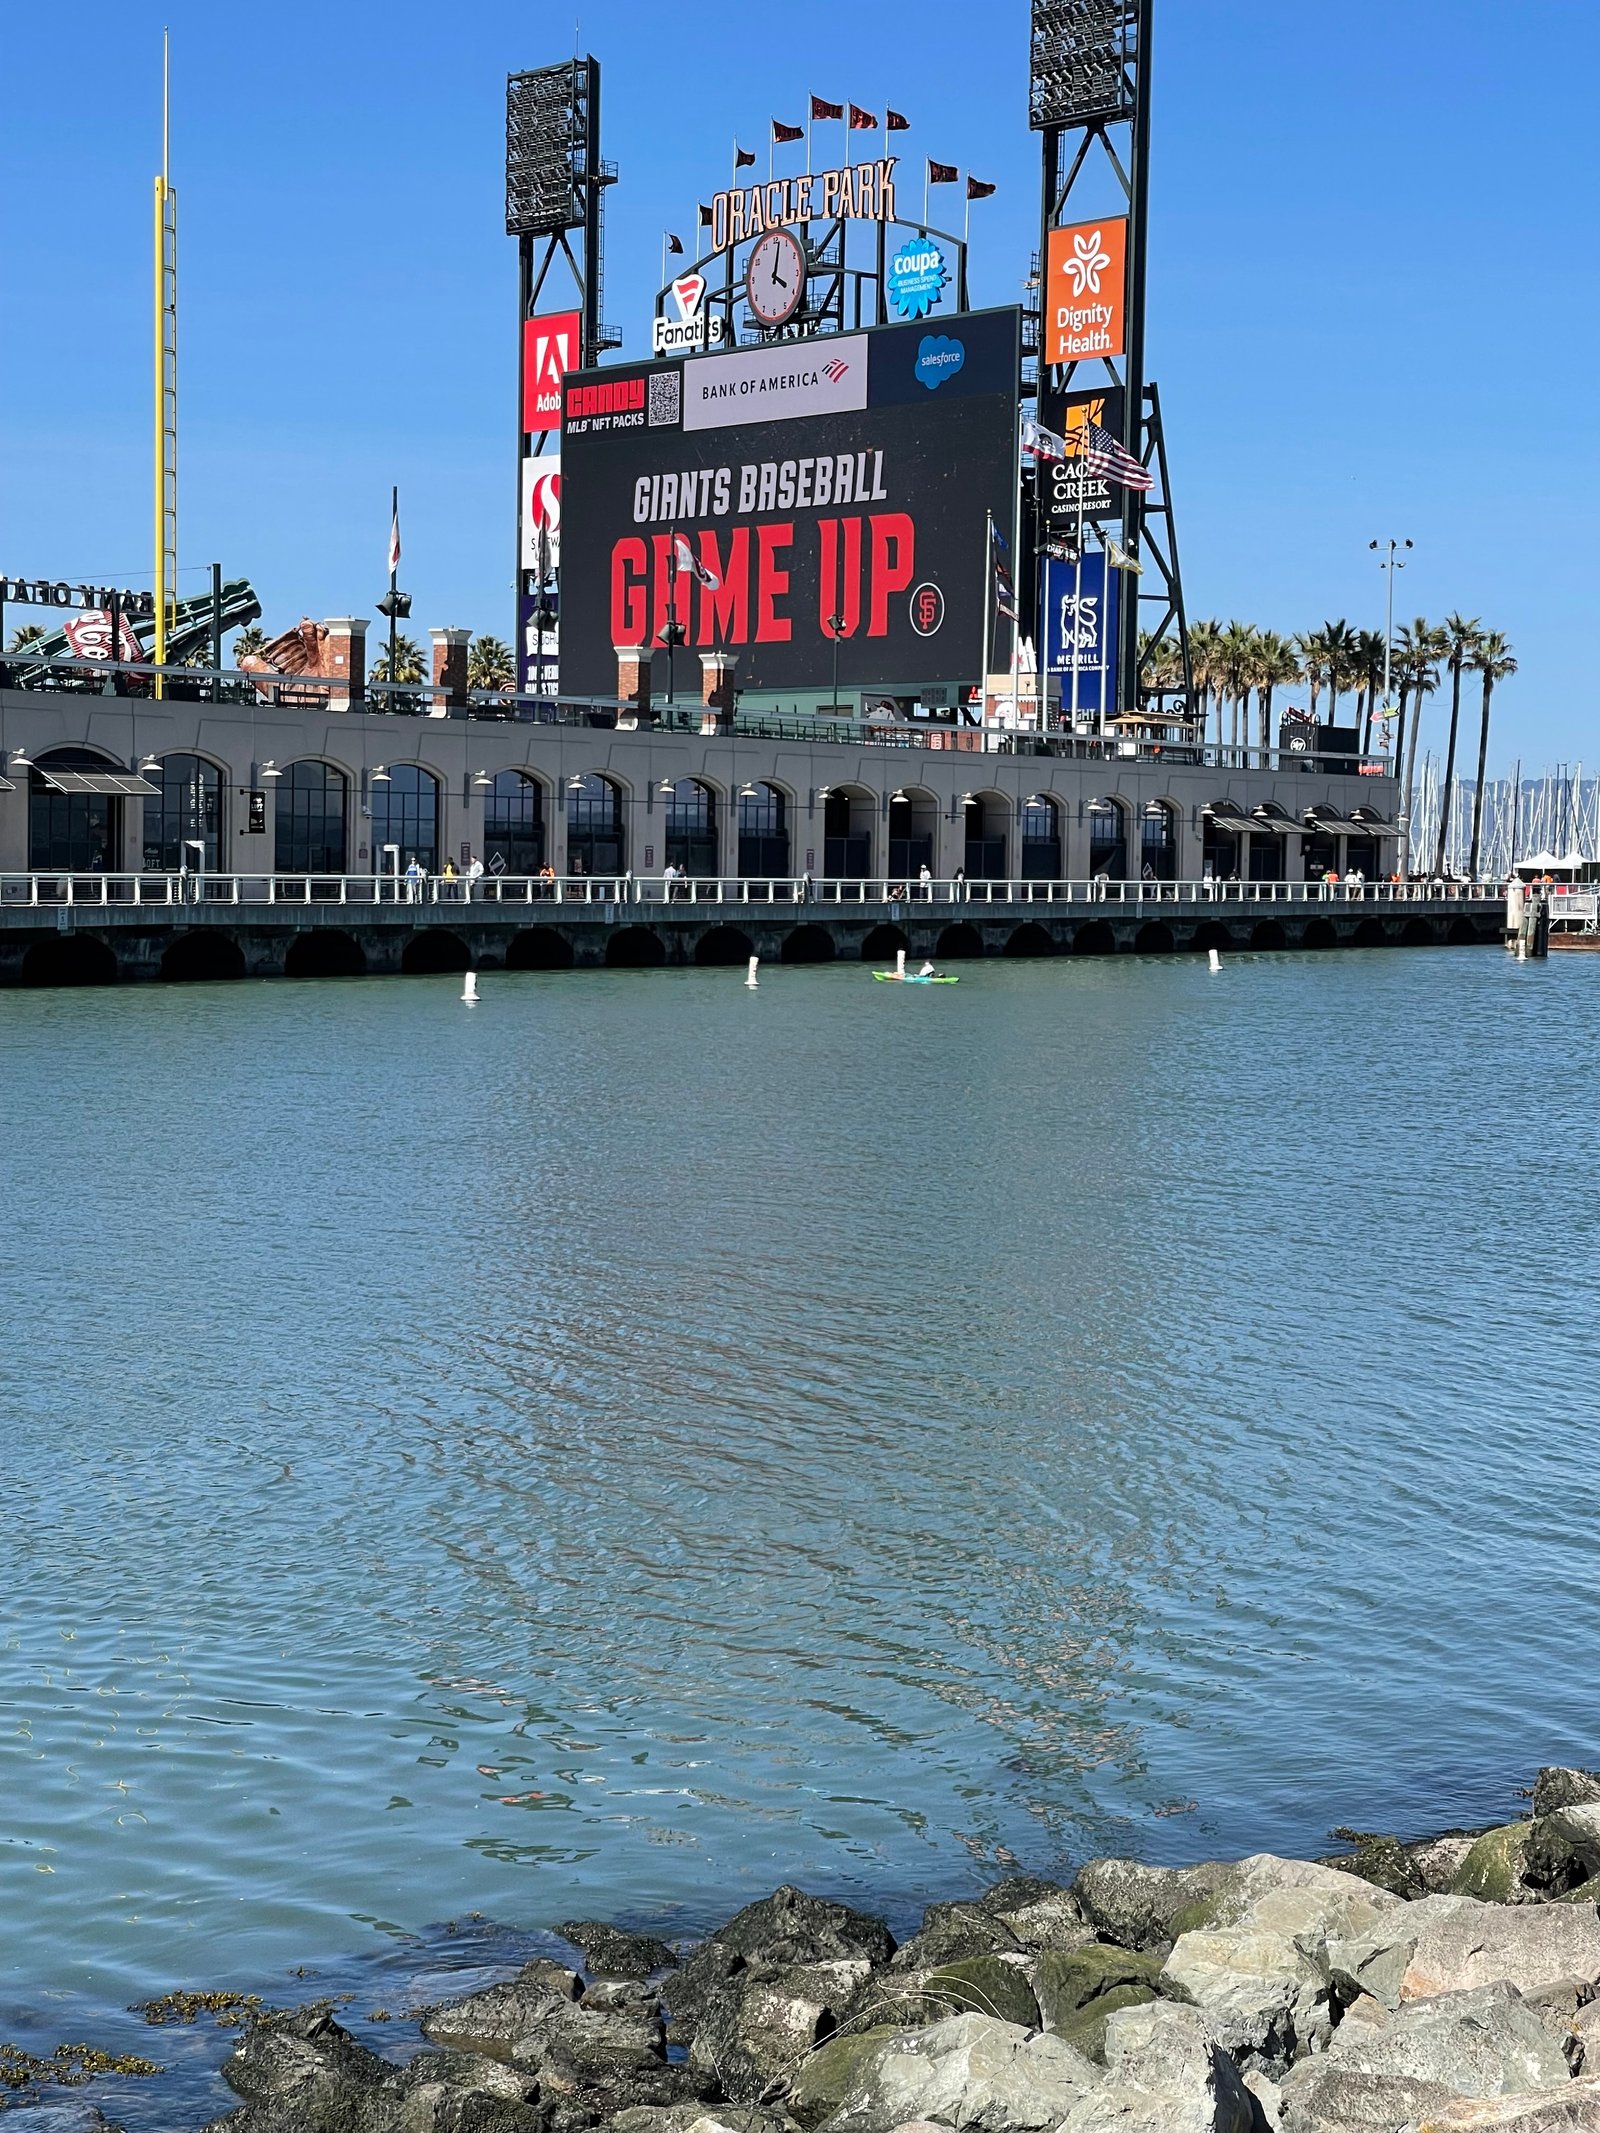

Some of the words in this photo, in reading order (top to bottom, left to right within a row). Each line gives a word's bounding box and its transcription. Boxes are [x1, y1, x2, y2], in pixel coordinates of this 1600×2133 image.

[711, 174, 814, 253] ORACLE
[822, 157, 897, 222] PARK
[894, 251, 940, 276] coupa
[1057, 302, 1113, 332] Dignity
[656, 317, 719, 346] Fanatis
[921, 352, 961, 367] salesforce
[566, 379, 645, 418] CANDY
[702, 383, 736, 400] BANK
[740, 380, 756, 395] OF
[759, 372, 819, 393] AMERICA
[536, 391, 562, 413] Adob
[592, 417, 611, 431] NFT
[613, 412, 645, 428] PACKS
[1052, 462, 1092, 480] CAC
[633, 467, 731, 523] GIANTS
[737, 450, 887, 514] BASEBALL
[1053, 479, 1110, 500] CREEK
[1051, 503, 1080, 514] CASINO
[1082, 500, 1112, 511] RESORT
[611, 522, 794, 649] GAME
[817, 513, 915, 639] UP
